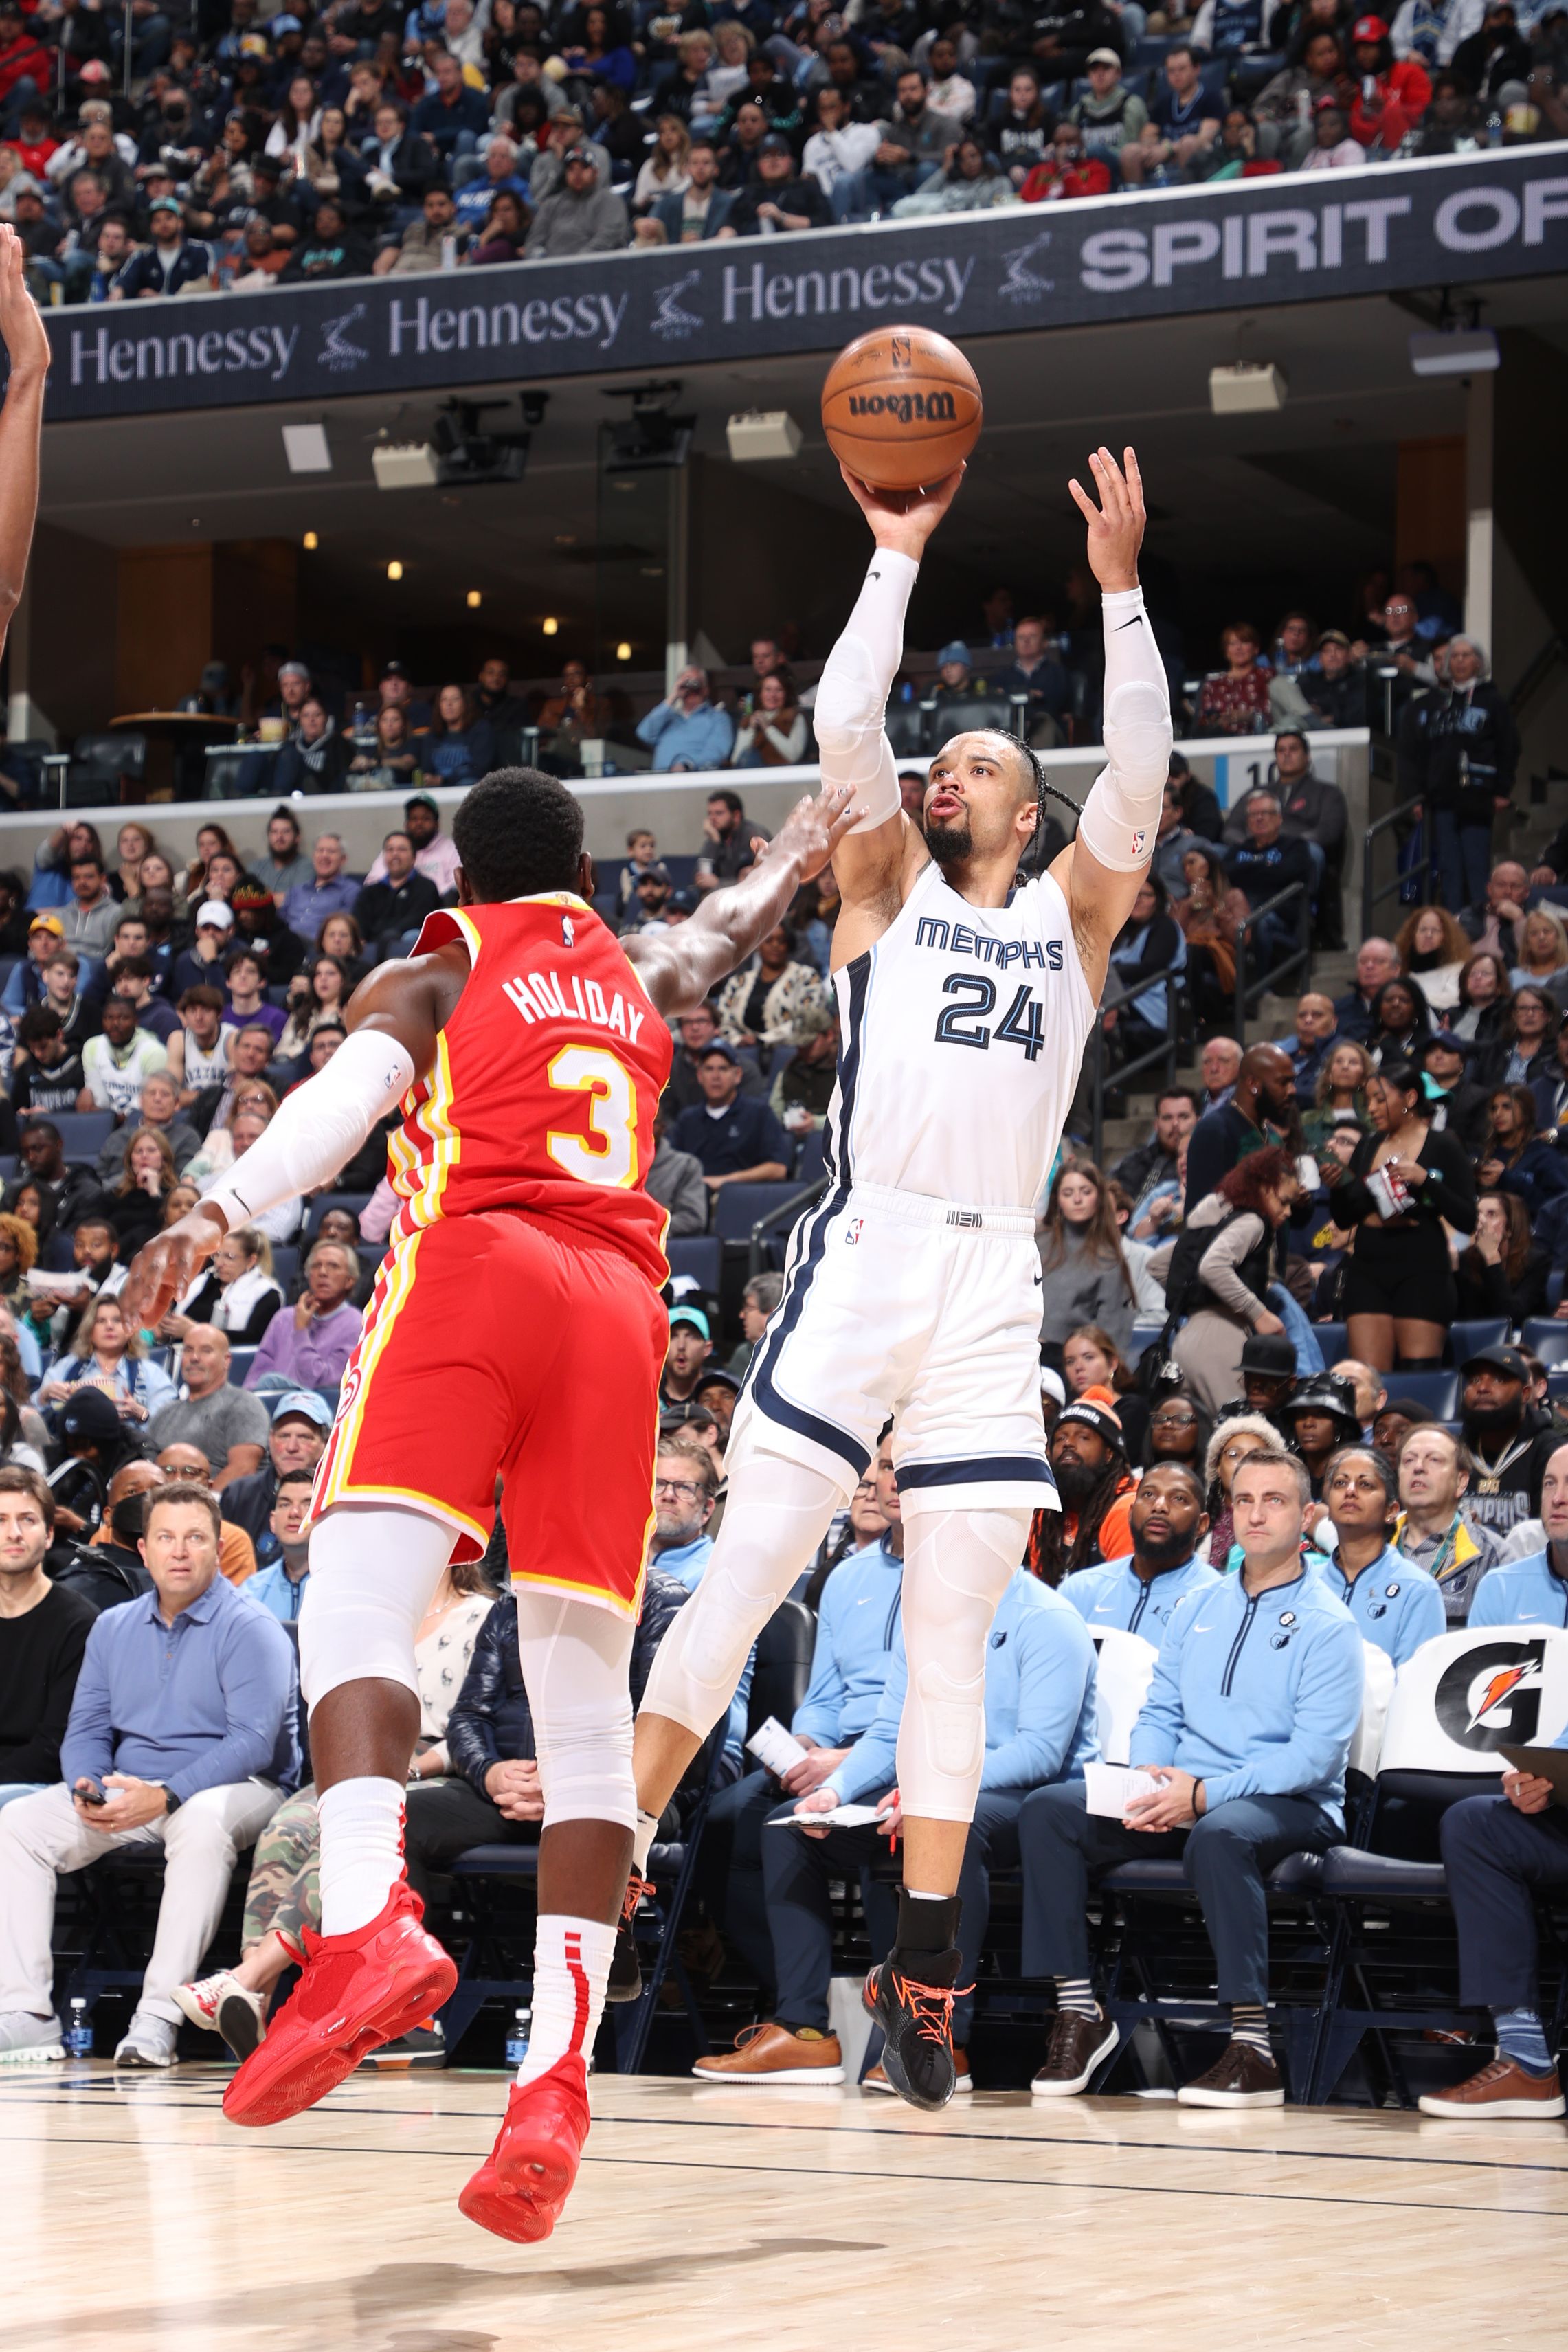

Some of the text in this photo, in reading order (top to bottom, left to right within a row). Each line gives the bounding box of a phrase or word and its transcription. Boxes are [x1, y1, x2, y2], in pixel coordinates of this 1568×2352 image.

[1079, 176, 1568, 292] SPIRIT OF
[389, 291, 629, 357] Hennessy
[723, 255, 975, 324] Hennessy
[70, 324, 300, 387] Hennessy
[849, 392, 956, 423] Wilson
[915, 917, 1063, 970] MEMPHS
[502, 972, 644, 1044] HOLIDAY
[934, 972, 1045, 1062] 24
[546, 1043, 638, 1189] 3
[1435, 1639, 1547, 1753] G
